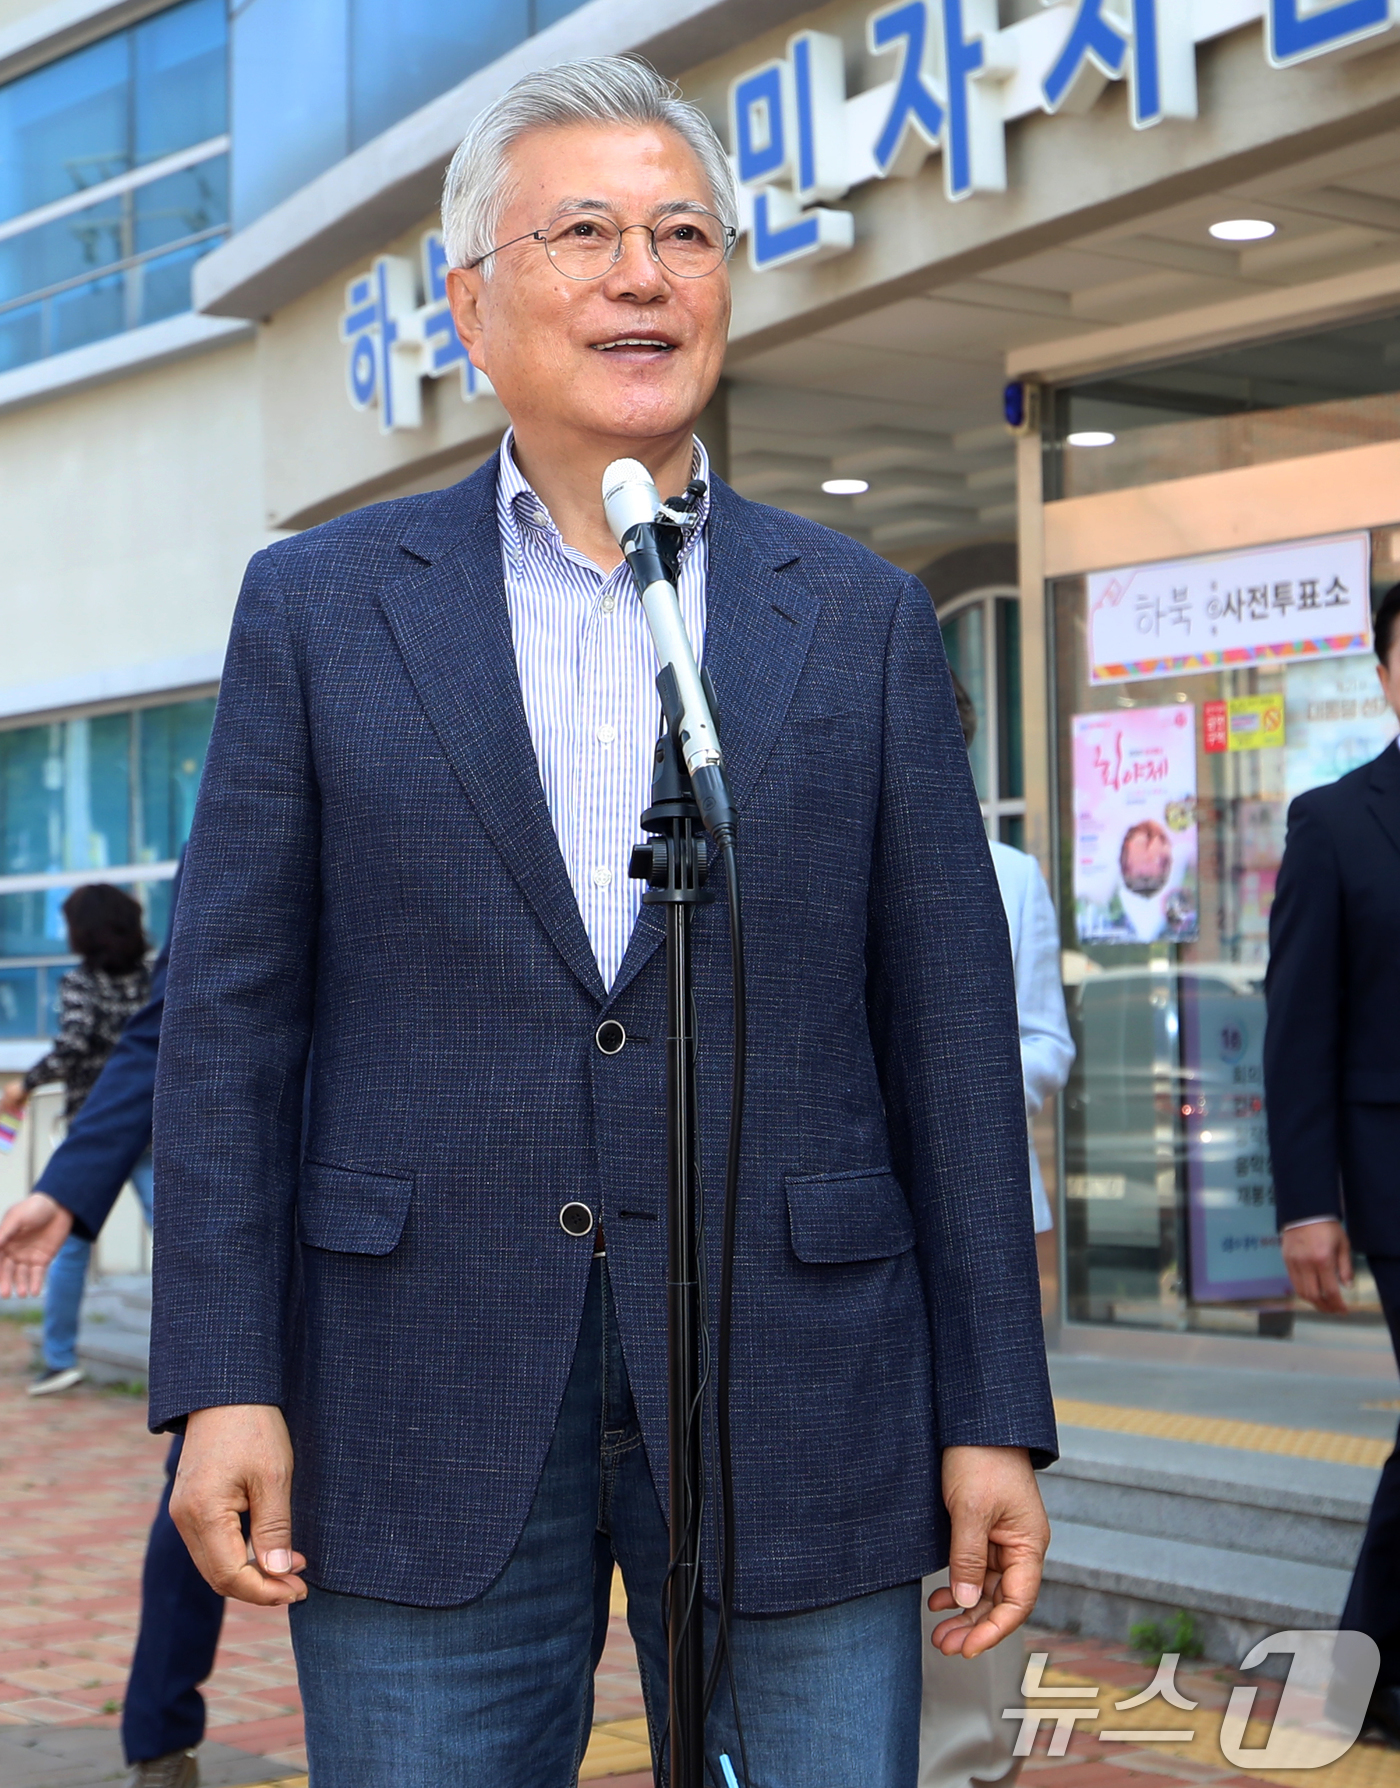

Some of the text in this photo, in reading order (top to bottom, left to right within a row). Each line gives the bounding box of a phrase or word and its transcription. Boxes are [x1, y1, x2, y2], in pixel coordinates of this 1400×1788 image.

[728, 0, 1394, 272] 민자치
[1134, 576, 1351, 638] 하북 사전투표소
